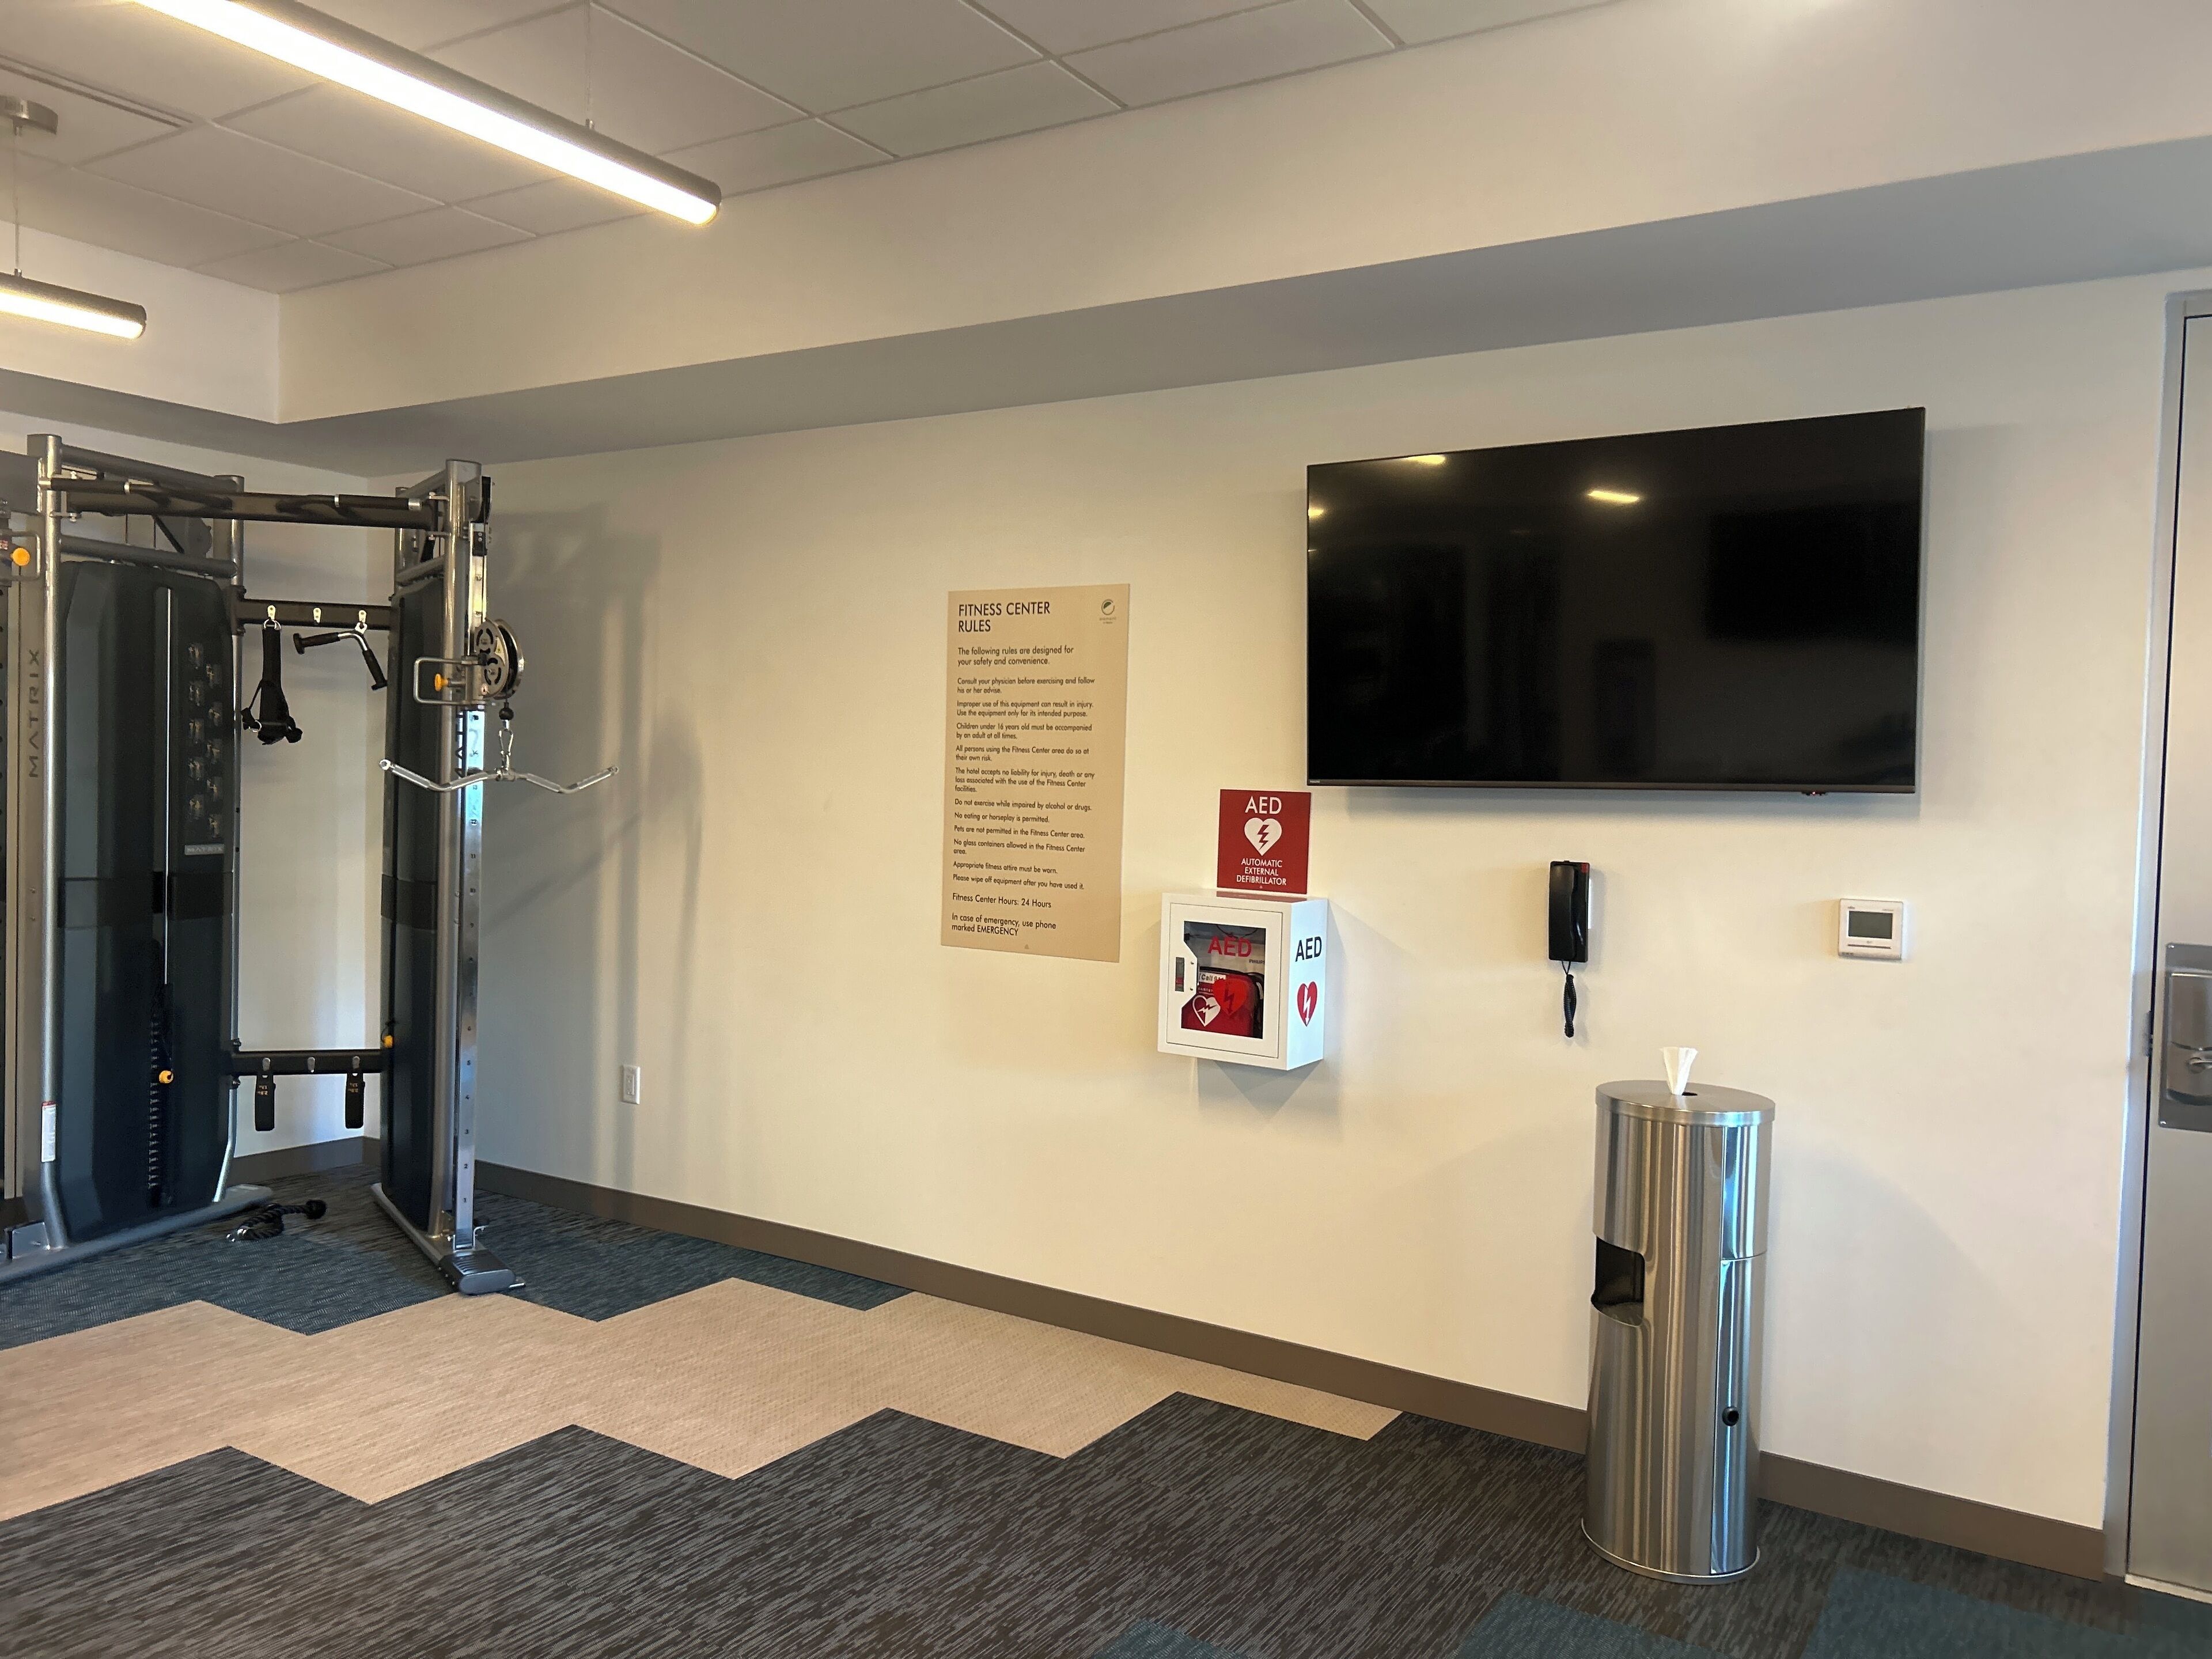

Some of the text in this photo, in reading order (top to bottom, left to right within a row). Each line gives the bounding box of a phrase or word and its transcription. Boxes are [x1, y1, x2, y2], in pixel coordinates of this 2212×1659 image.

[959, 601, 1051, 617] FITNESS CENTER
[958, 619, 991, 632] RULES
[957, 647, 970, 656] The
[971, 646, 1000, 657] following
[1002, 646, 1018, 655] rules
[1032, 645, 1062, 656] designed
[1064, 645, 1074, 654] for
[973, 657, 993, 666] safety
[994, 656, 1006, 665] and
[29, 649, 39, 778] MATRIX
[1244, 796, 1282, 815] AED
[1241, 858, 1283, 868] AUTOMATIC
[1244, 866, 1279, 876] EXTERNAL
[1236, 874, 1287, 885] DEFIBRILLATOR
[952, 893, 1052, 908] Fitness Center Hours: 24 Hours
[952, 912, 958, 921] In
[975, 914, 982, 923] of
[1035, 919, 1056, 932] phone
[952, 922, 1018, 936] marked EMERGENCY
[1207, 934, 1252, 957] AED
[1295, 936, 1322, 962] AED
